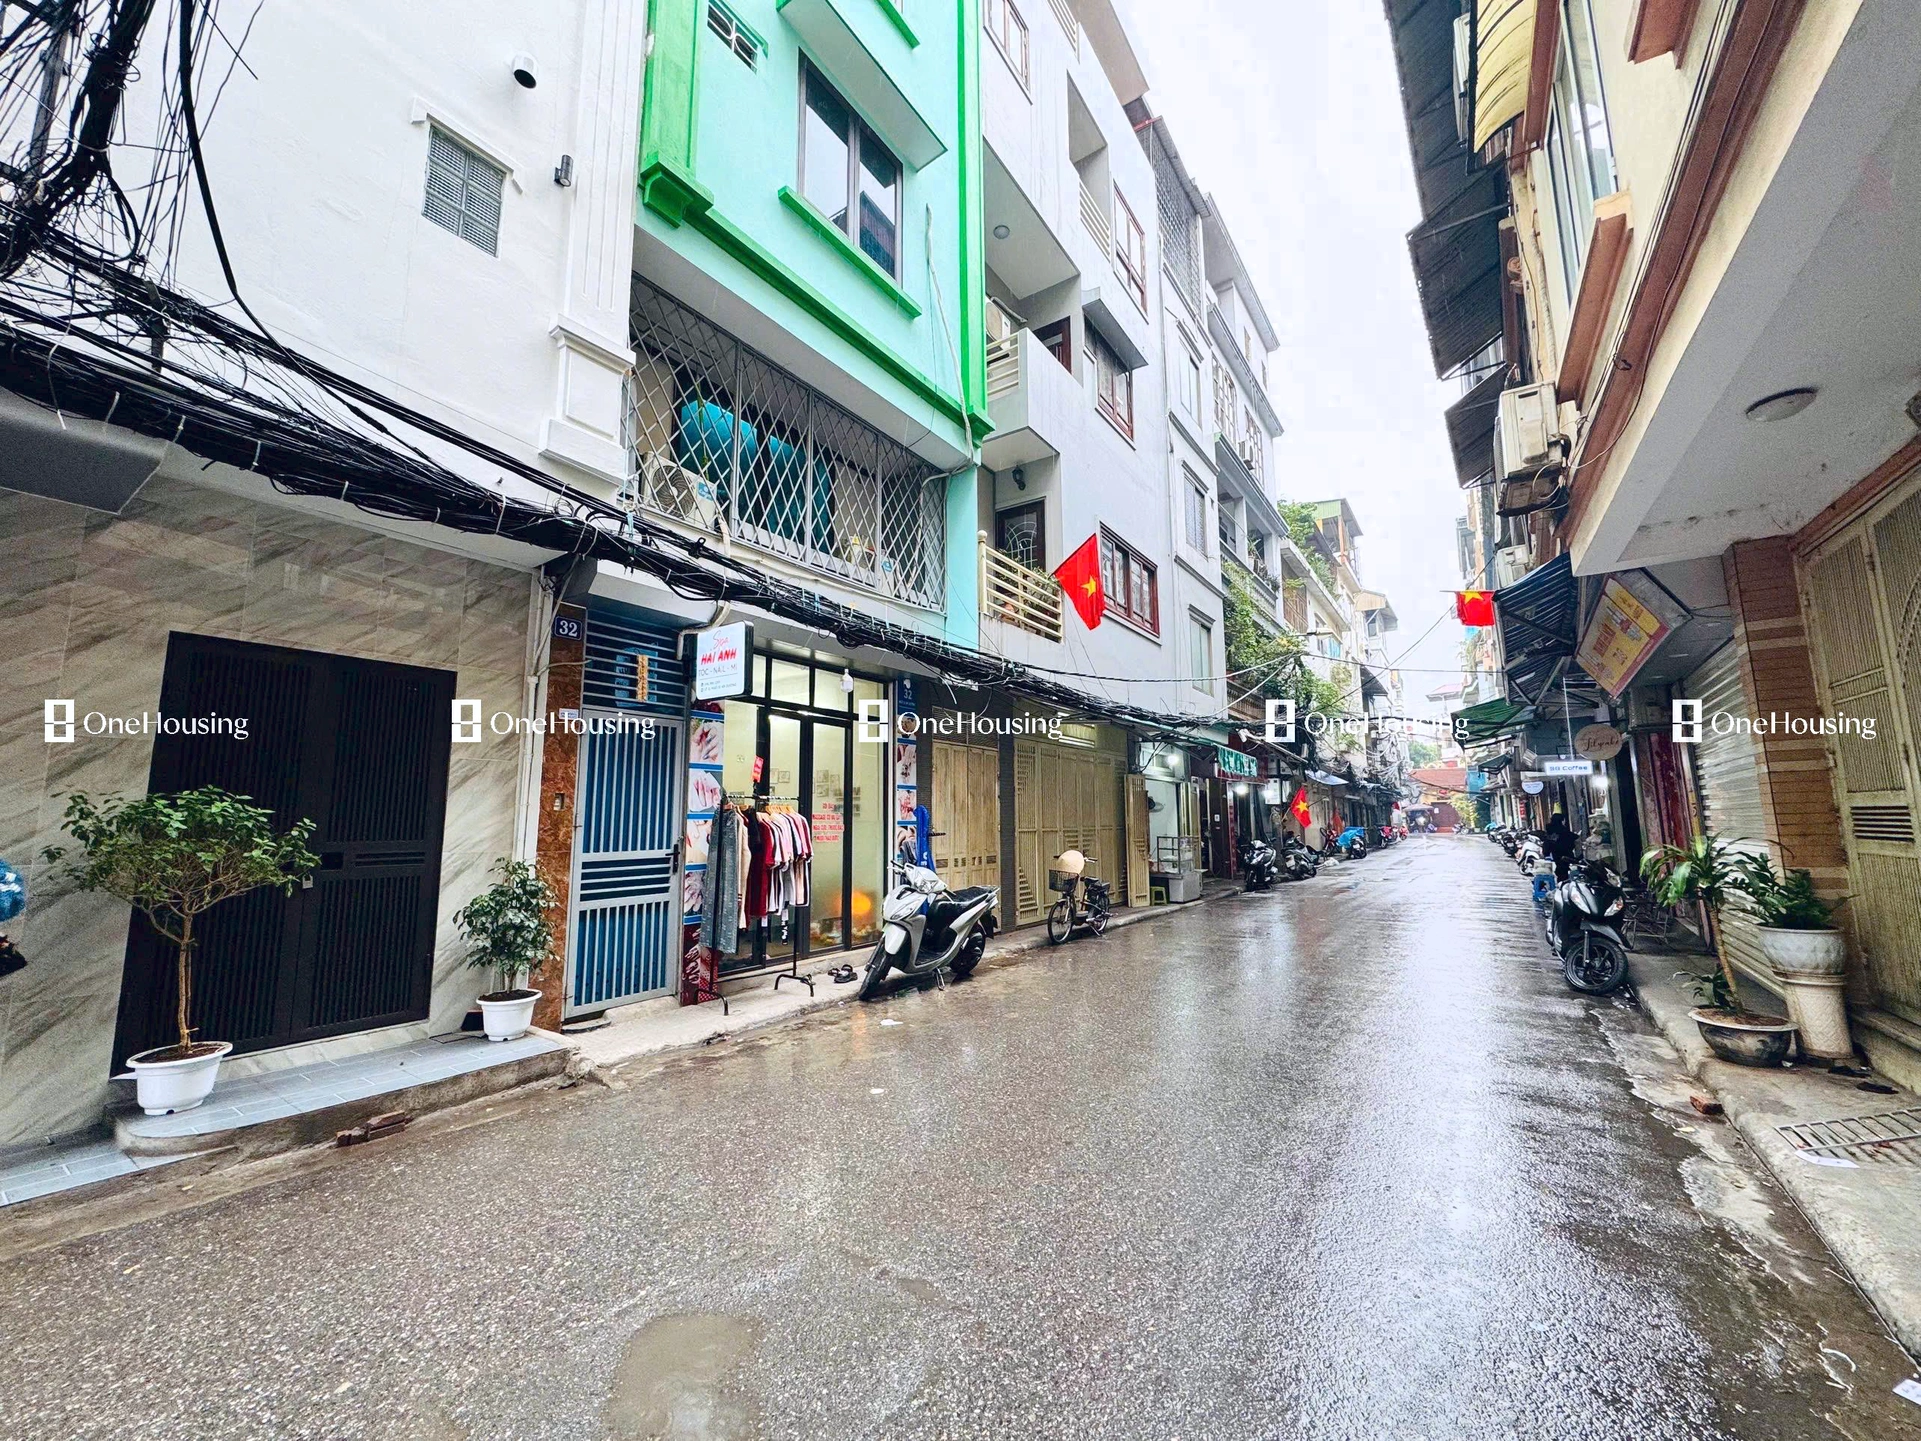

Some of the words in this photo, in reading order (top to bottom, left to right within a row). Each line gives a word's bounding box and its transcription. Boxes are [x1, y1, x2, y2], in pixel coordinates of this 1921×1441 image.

[559, 620, 578, 637] 32
[713, 630, 729, 650] Spa
[718, 648, 738, 662] ANH
[903, 689, 913, 700] 32
